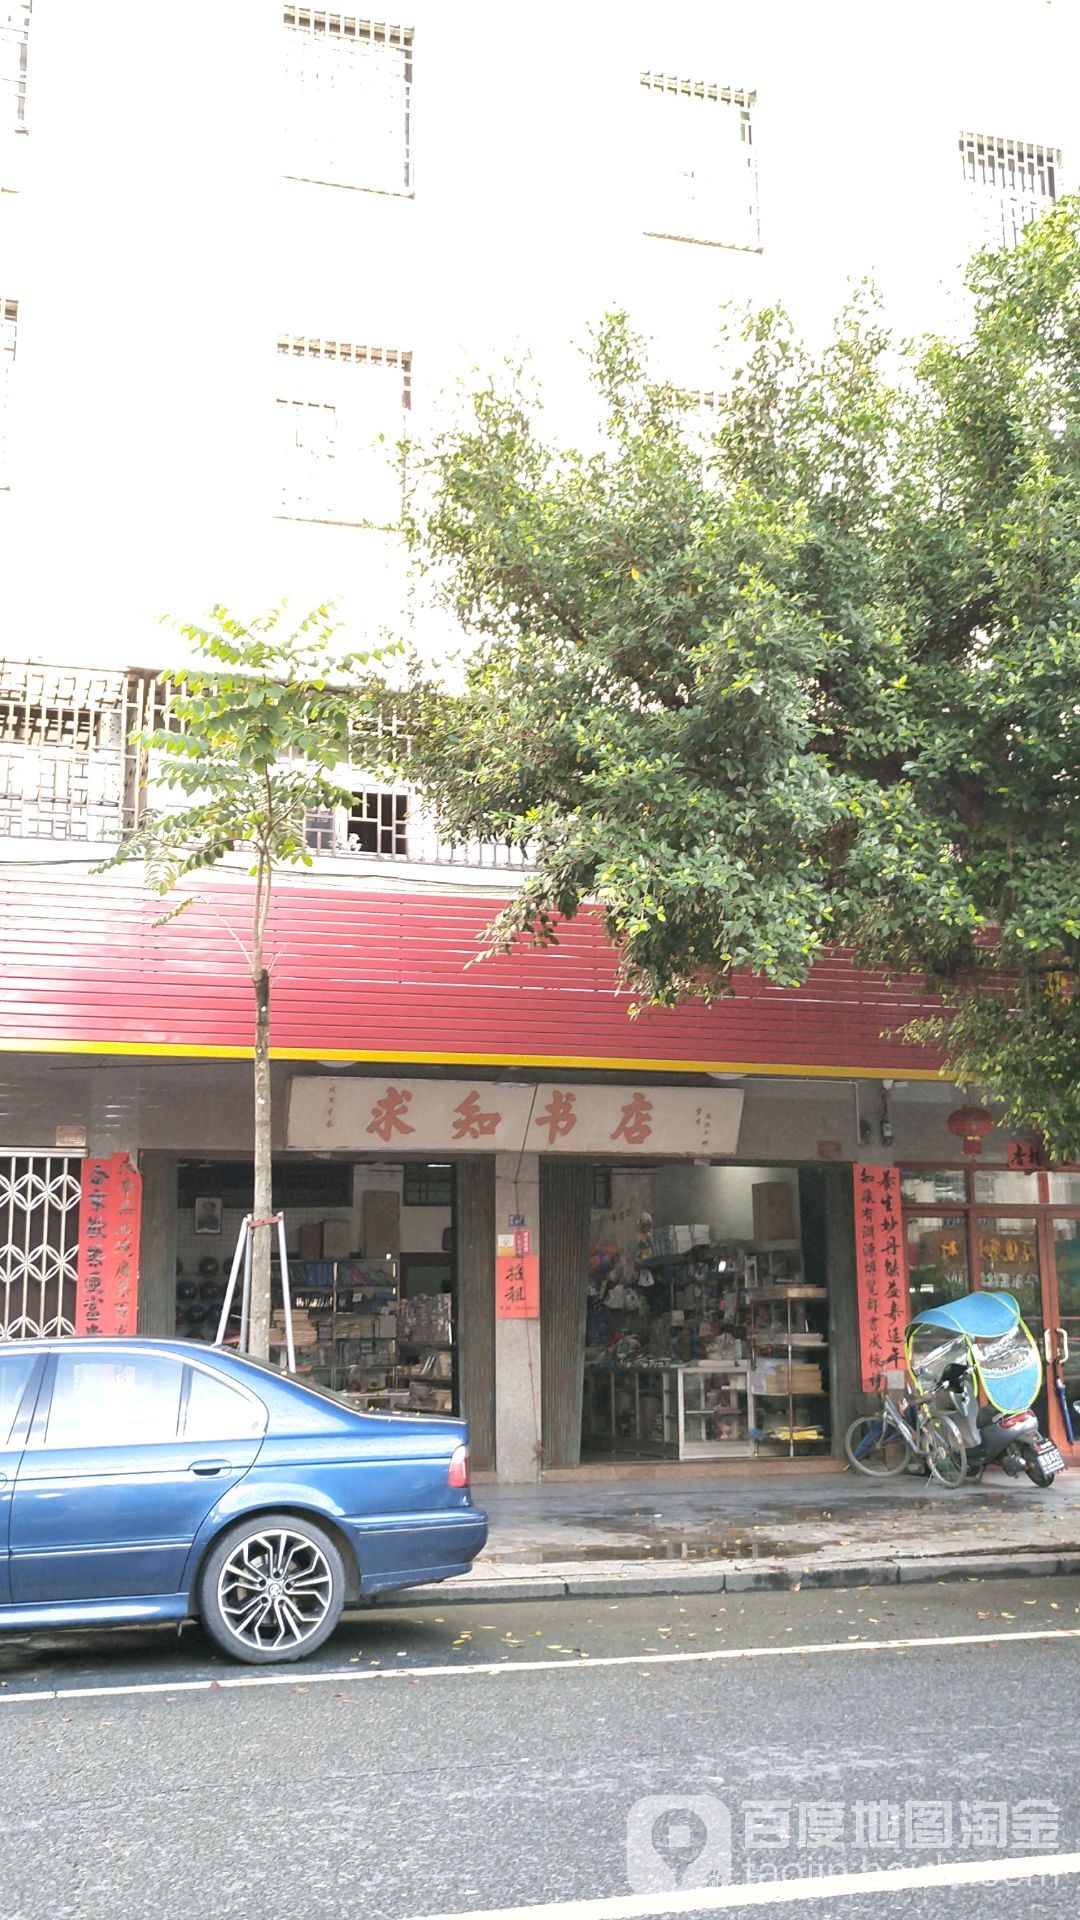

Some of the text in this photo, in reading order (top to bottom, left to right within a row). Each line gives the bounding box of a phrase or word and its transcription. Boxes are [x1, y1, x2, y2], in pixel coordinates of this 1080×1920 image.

[366, 1086, 653, 1146] 求知书店
[505, 1264, 526, 1303] 招租
